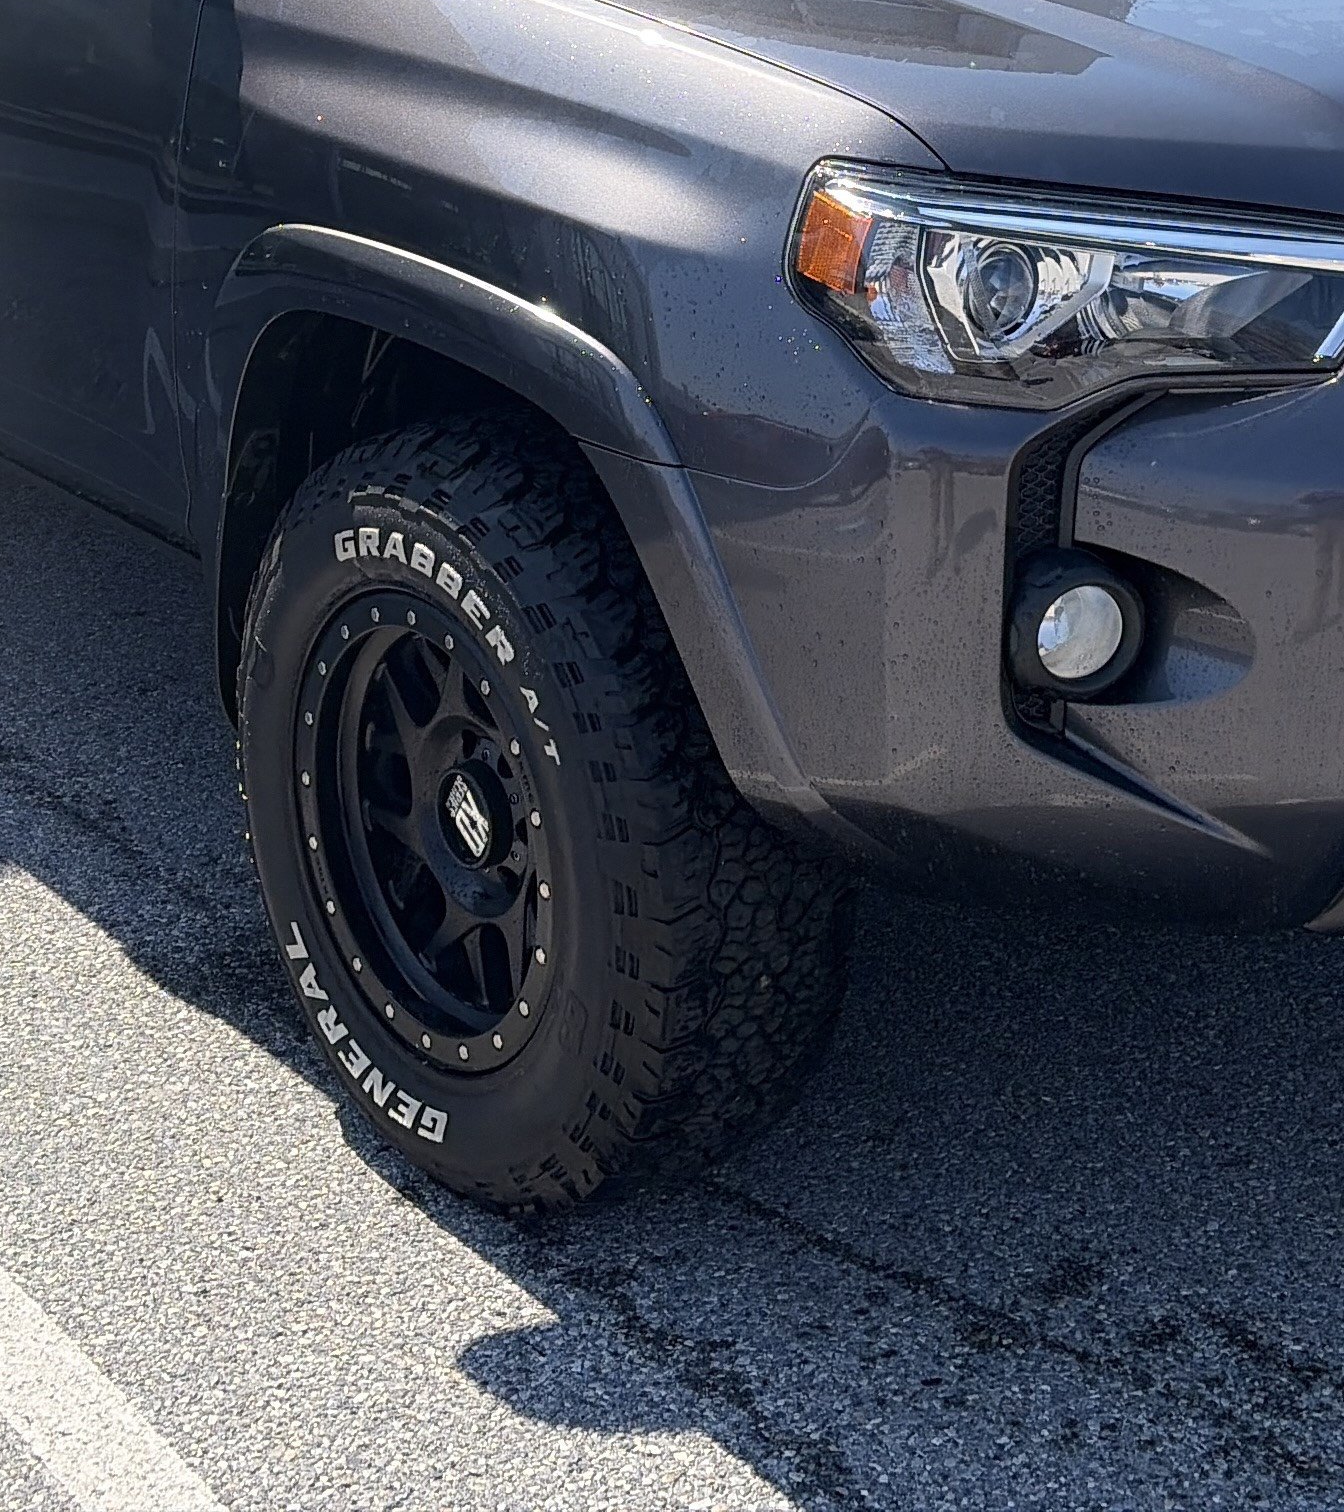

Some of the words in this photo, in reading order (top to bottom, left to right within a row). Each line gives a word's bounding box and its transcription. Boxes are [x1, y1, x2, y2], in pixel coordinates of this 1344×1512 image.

[334, 526, 515, 667] GRABBER
[519, 686, 561, 766] A/T
[285, 921, 449, 1144] GENERAL
